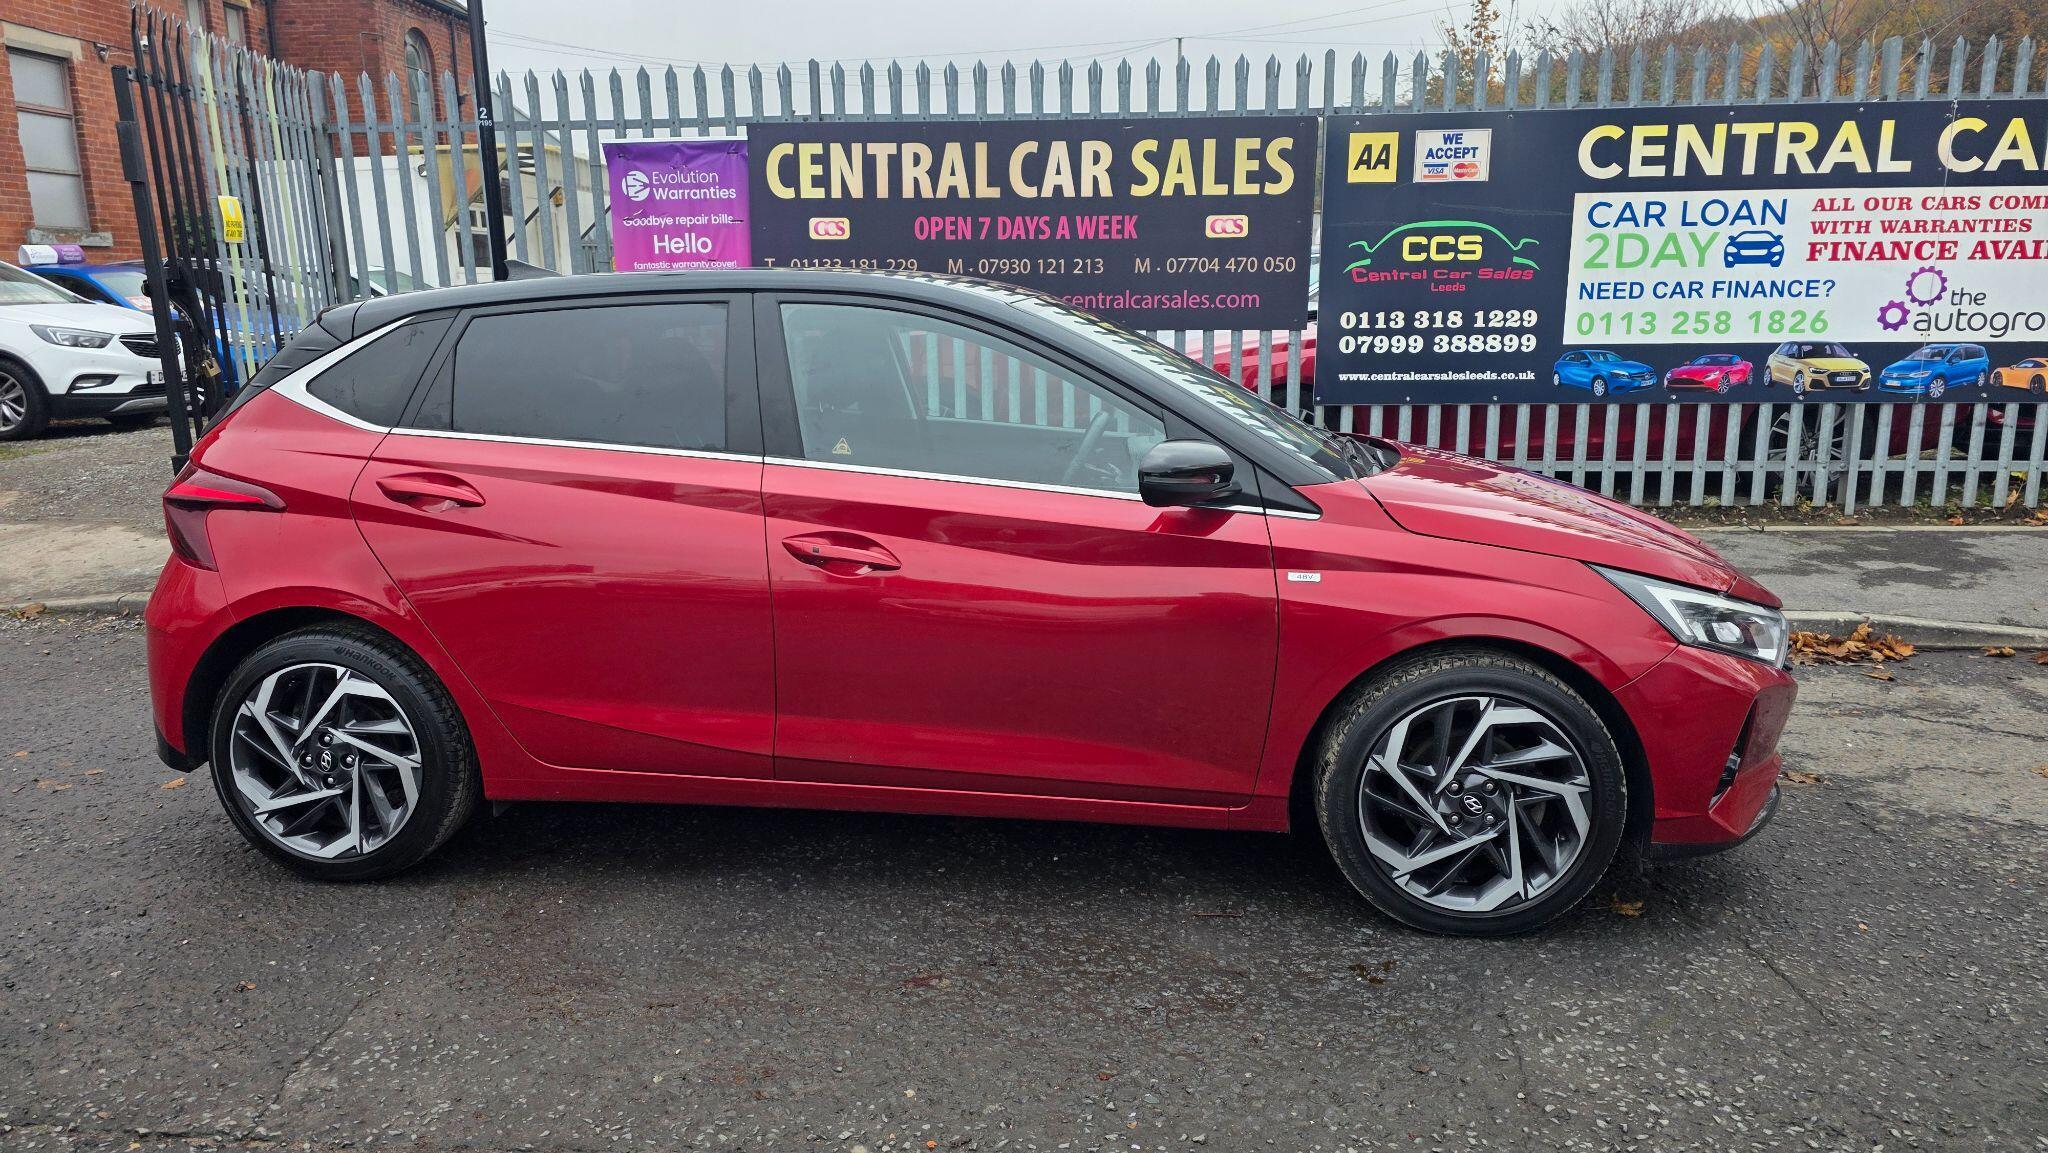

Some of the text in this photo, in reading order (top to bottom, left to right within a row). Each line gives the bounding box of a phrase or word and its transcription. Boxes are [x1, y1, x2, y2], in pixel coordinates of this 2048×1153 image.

[480, 107, 488, 118] 2
[1443, 133, 1463, 145] WE
[1578, 117, 2048, 179] CENTRAL CA
[1354, 143, 1391, 170] AA
[1426, 147, 1479, 160] ACCEPT
[766, 136, 1295, 200] CENTRAL CAR SALES
[652, 170, 719, 186] Evolution
[653, 186, 737, 201] Warranties
[1812, 198, 1855, 212] ALL
[1862, 196, 1914, 212] OUR
[1921, 196, 1982, 210] CARS
[623, 215, 674, 228] Goodbye
[676, 214, 708, 228] repair
[1587, 199, 1788, 229] CAR LOAN
[812, 220, 846, 238] CCS
[914, 215, 1139, 241] OPEN 7 DAYS A WEEK
[1210, 218, 1244, 235] CCS
[1810, 218, 2032, 234] WITH WARRANTIES
[653, 232, 712, 254] Hello
[1402, 235, 1483, 262] CCS
[1583, 232, 1721, 269] 2DAY
[1806, 240, 2048, 262] FINANCE AVAI
[634, 260, 671, 270] fantastic
[672, 260, 710, 269] warranty
[764, 258, 776, 268] T
[850, 258, 878, 270] 181
[978, 258, 1031, 274] 07930
[1038, 258, 1066, 274] 121
[1073, 258, 1104, 274] 213
[1166, 257, 1220, 273] 07704
[1225, 256, 1258, 273] 470
[1263, 256, 1296, 273] 050
[1352, 266, 1534, 284] Central Car Sales
[1430, 282, 1466, 292] Leeds
[1578, 279, 1836, 300] NEED CAR FINANCE?
[1950, 288, 1987, 306] the
[1340, 309, 1538, 329] 0113 318 1229
[1576, 310, 1830, 336] 0113 258 1826
[1912, 308, 2048, 338] autogro
[1338, 334, 1537, 354] 07999 388899
[1338, 370, 1536, 382] www.centralcarsalesleeds.co.uk
